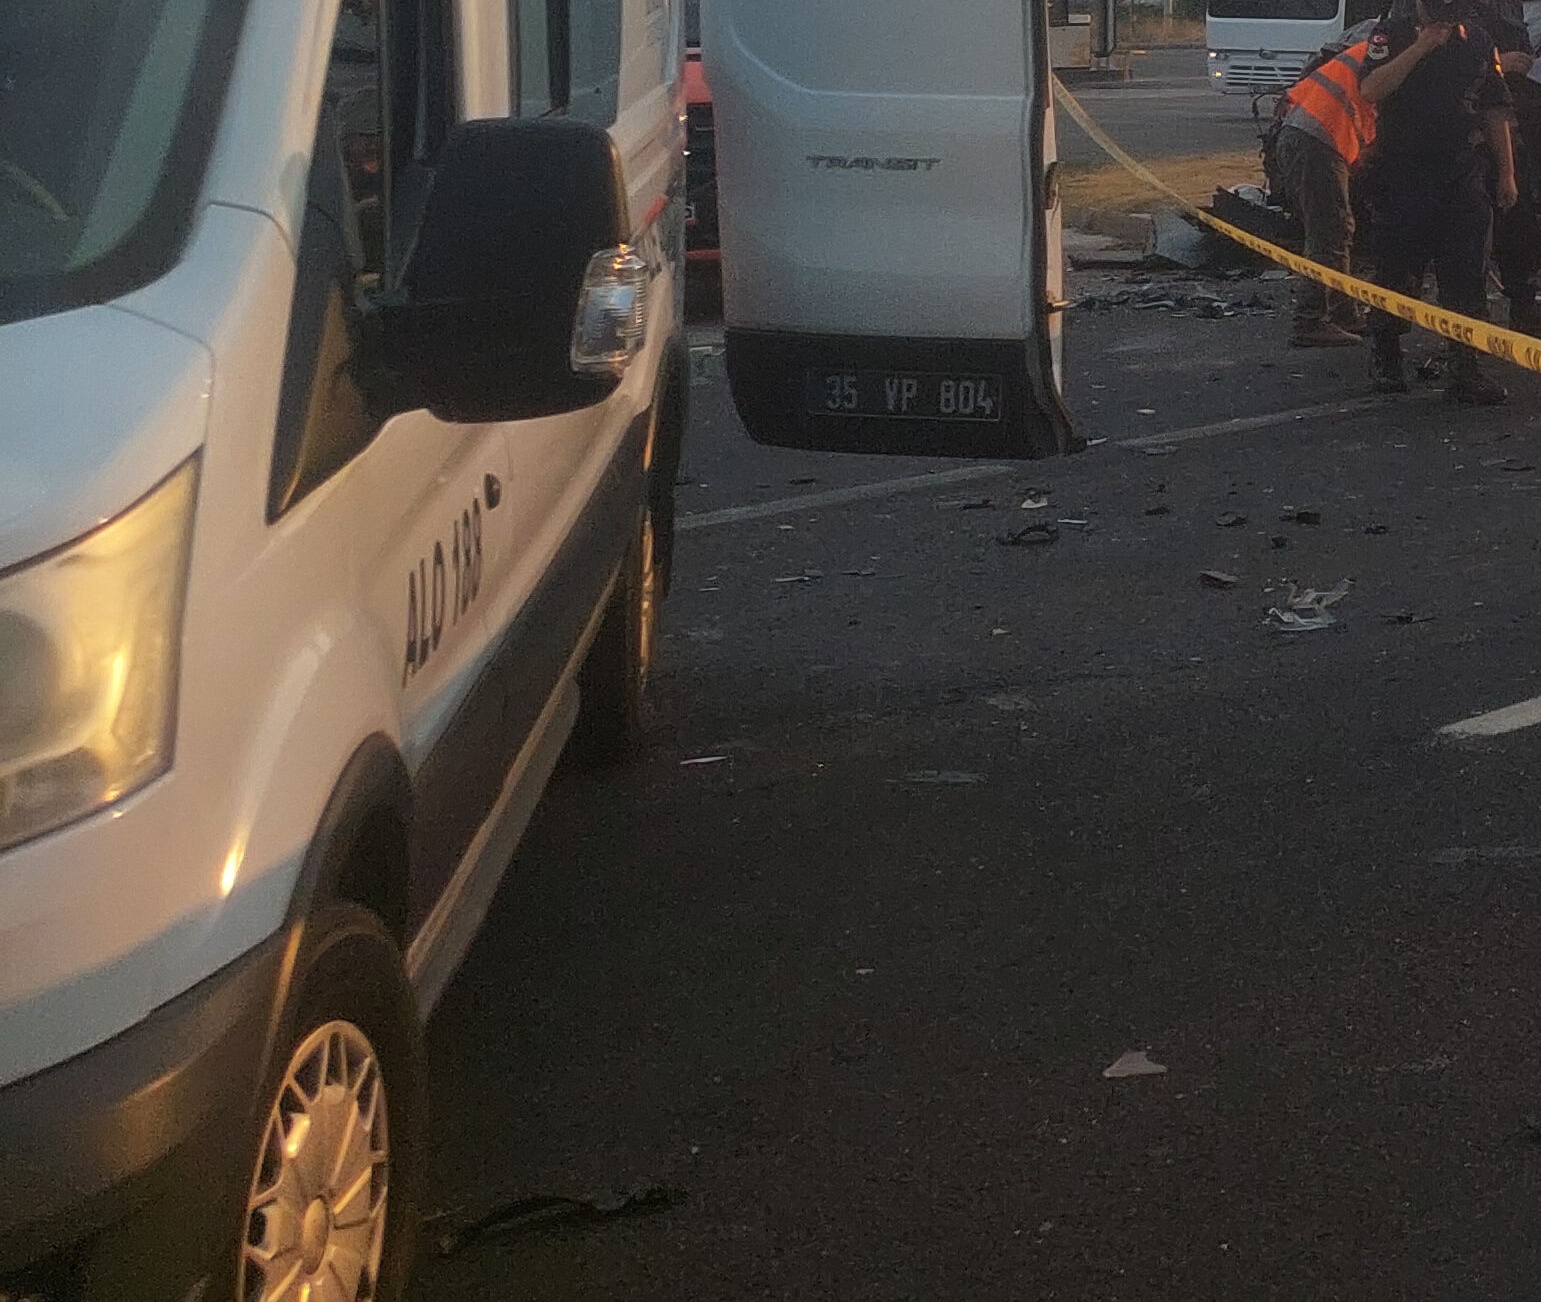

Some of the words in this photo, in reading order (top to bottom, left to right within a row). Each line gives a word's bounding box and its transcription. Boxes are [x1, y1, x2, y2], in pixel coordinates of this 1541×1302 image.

[805, 155, 942, 172] TRANSIT
[825, 375, 858, 410] 35
[939, 379, 994, 415] 804
